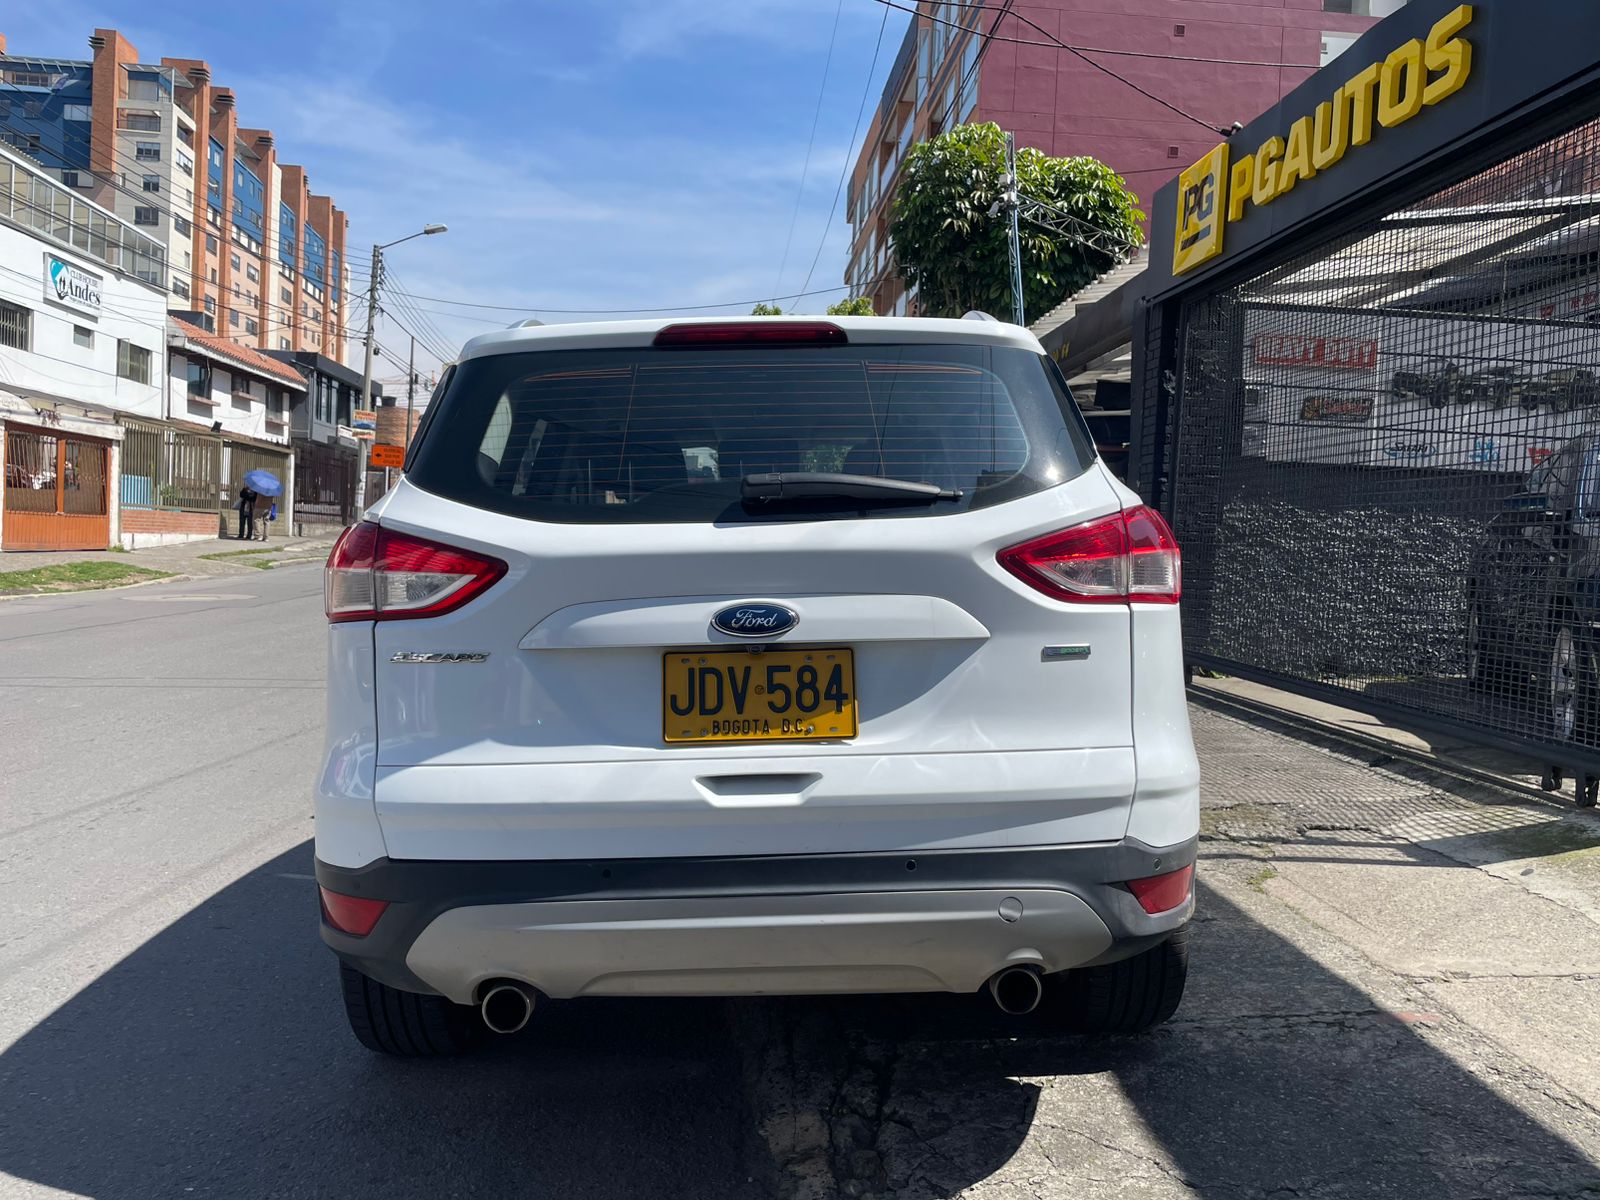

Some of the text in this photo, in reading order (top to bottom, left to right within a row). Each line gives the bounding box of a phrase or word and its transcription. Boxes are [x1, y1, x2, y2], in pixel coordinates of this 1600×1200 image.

[1227, 4, 1473, 222] PGAUTOS
[1182, 172, 1215, 232] PG
[67, 279, 101, 305] Andes
[731, 608, 777, 628] Ford
[670, 663, 849, 716] JDV 584
[712, 719, 771, 735] BOGOTA
